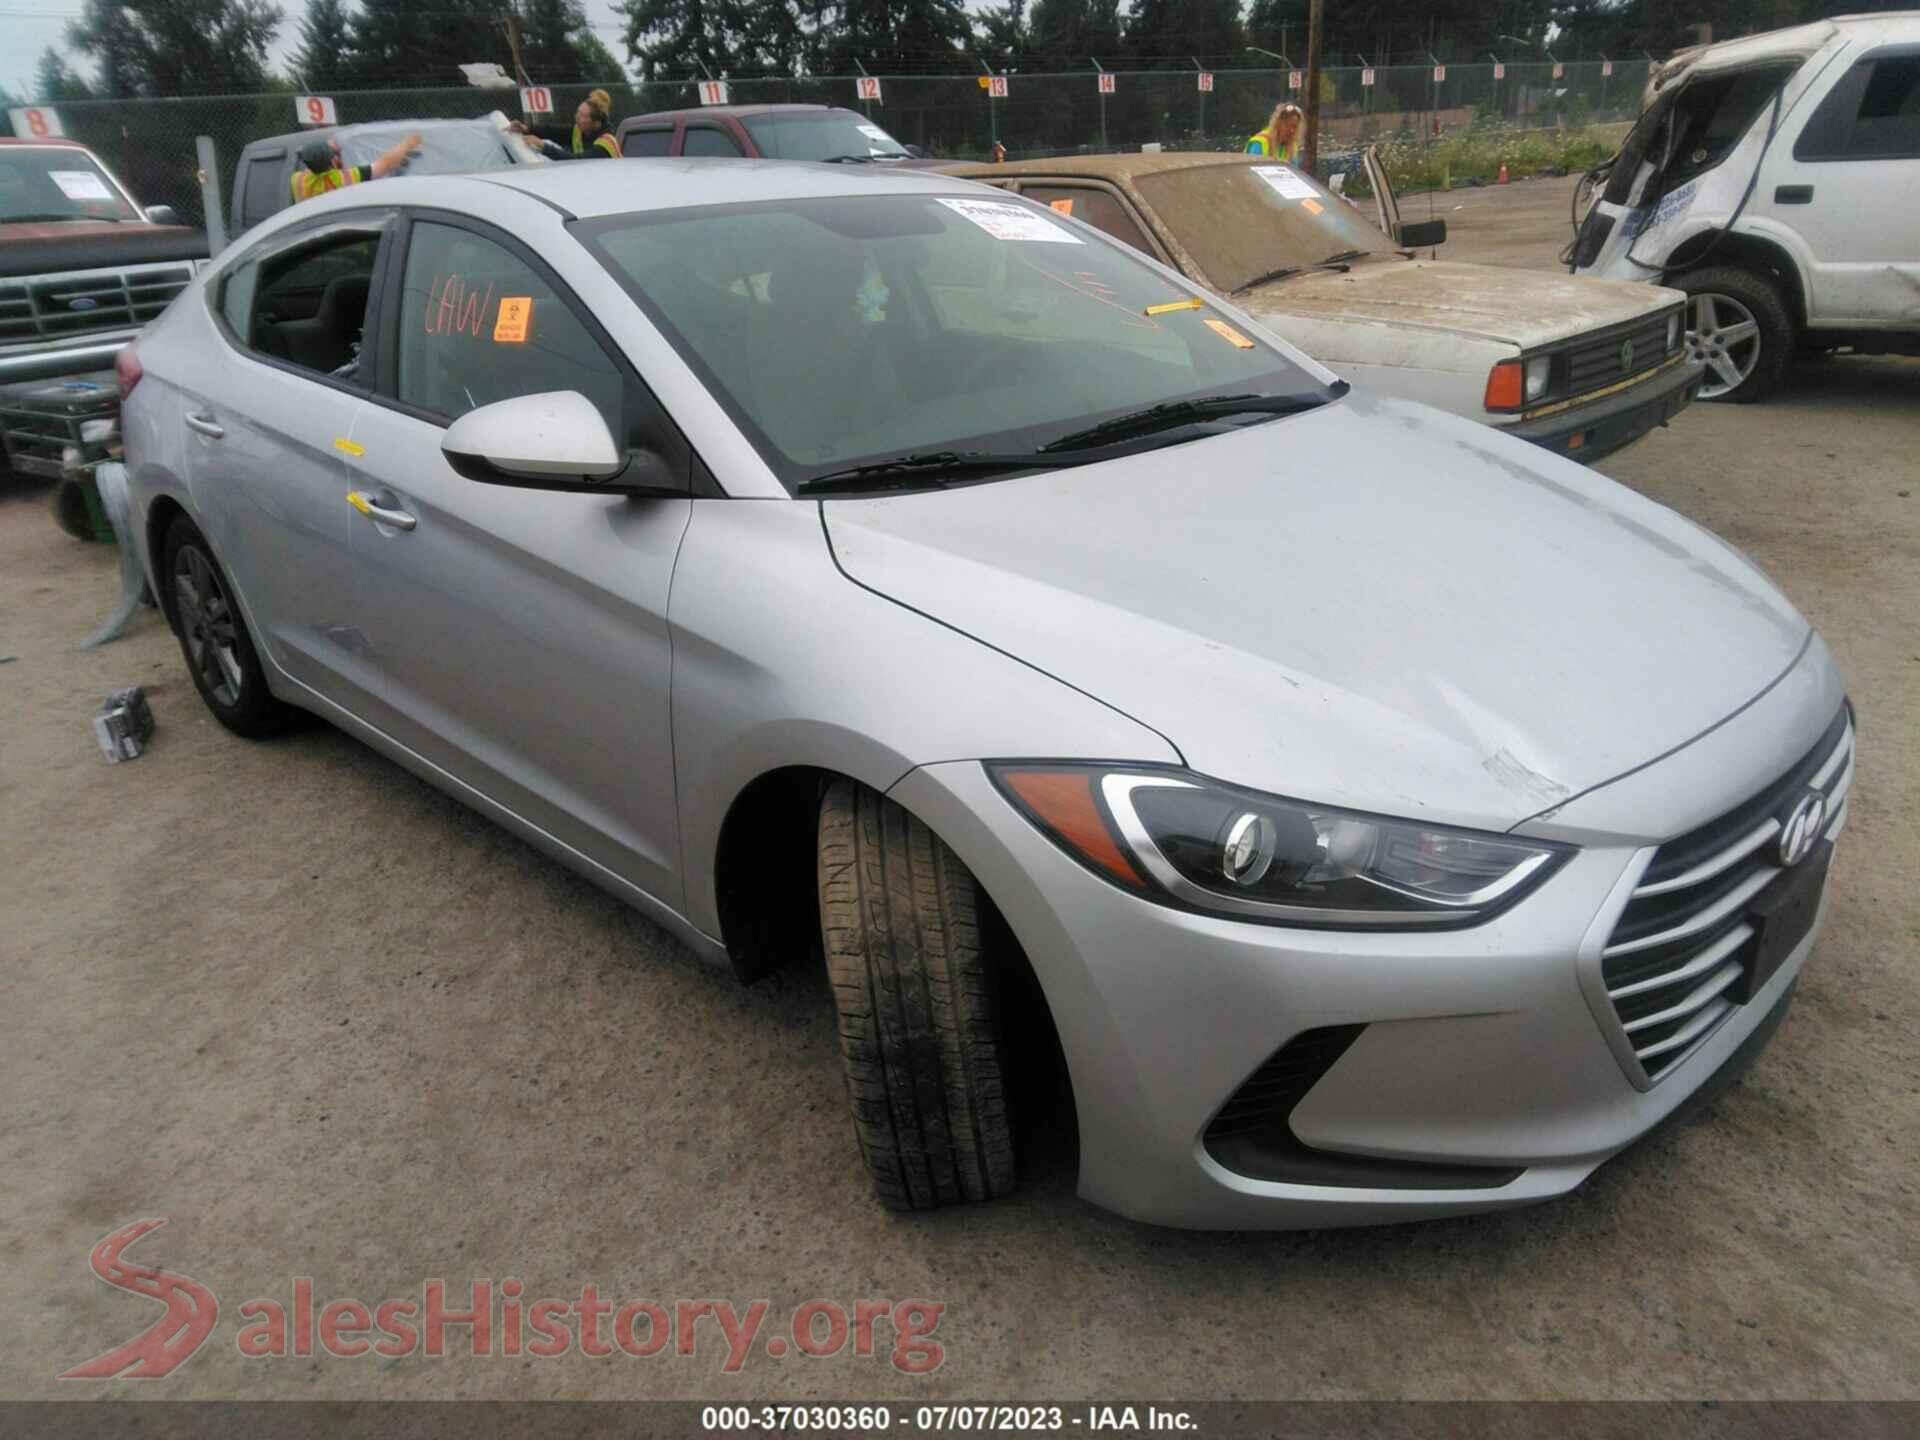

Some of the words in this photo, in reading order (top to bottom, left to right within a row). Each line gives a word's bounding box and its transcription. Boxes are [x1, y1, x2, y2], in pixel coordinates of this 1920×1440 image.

[705, 81, 721, 103] 11
[861, 79, 877, 97] 12
[991, 78, 1005, 96] 13
[307, 97, 325, 122] 9
[526, 89, 547, 111] 10
[25, 109, 48, 134] 8
